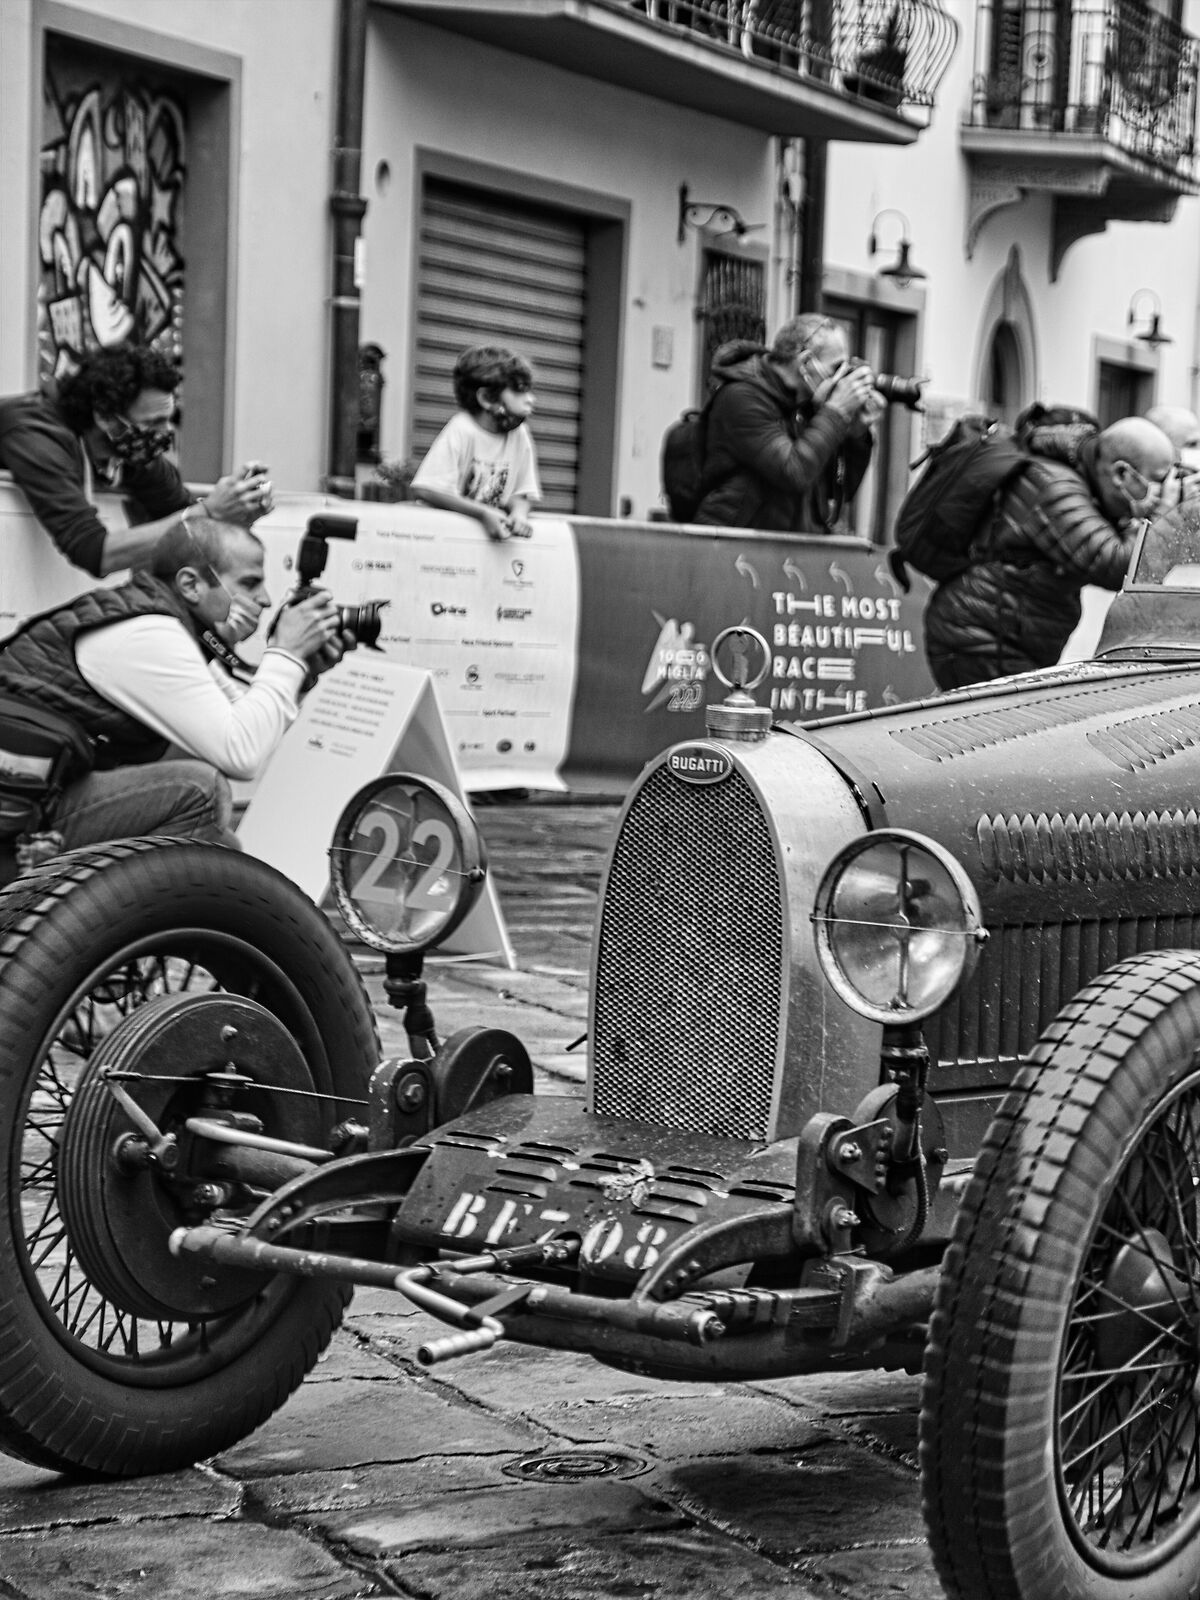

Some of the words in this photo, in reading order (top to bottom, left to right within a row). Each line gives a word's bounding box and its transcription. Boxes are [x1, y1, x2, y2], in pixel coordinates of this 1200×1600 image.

[772, 592, 837, 617] THE
[841, 596, 901, 621] MOST
[773, 623, 916, 652] BEAUTIFUL
[656, 665, 705, 681] MIGLIA
[772, 655, 856, 681] RACE
[770, 687, 797, 711] IN
[803, 688, 868, 712] THE
[671, 755, 724, 773] BUGATTI
[350, 811, 455, 913] 22
